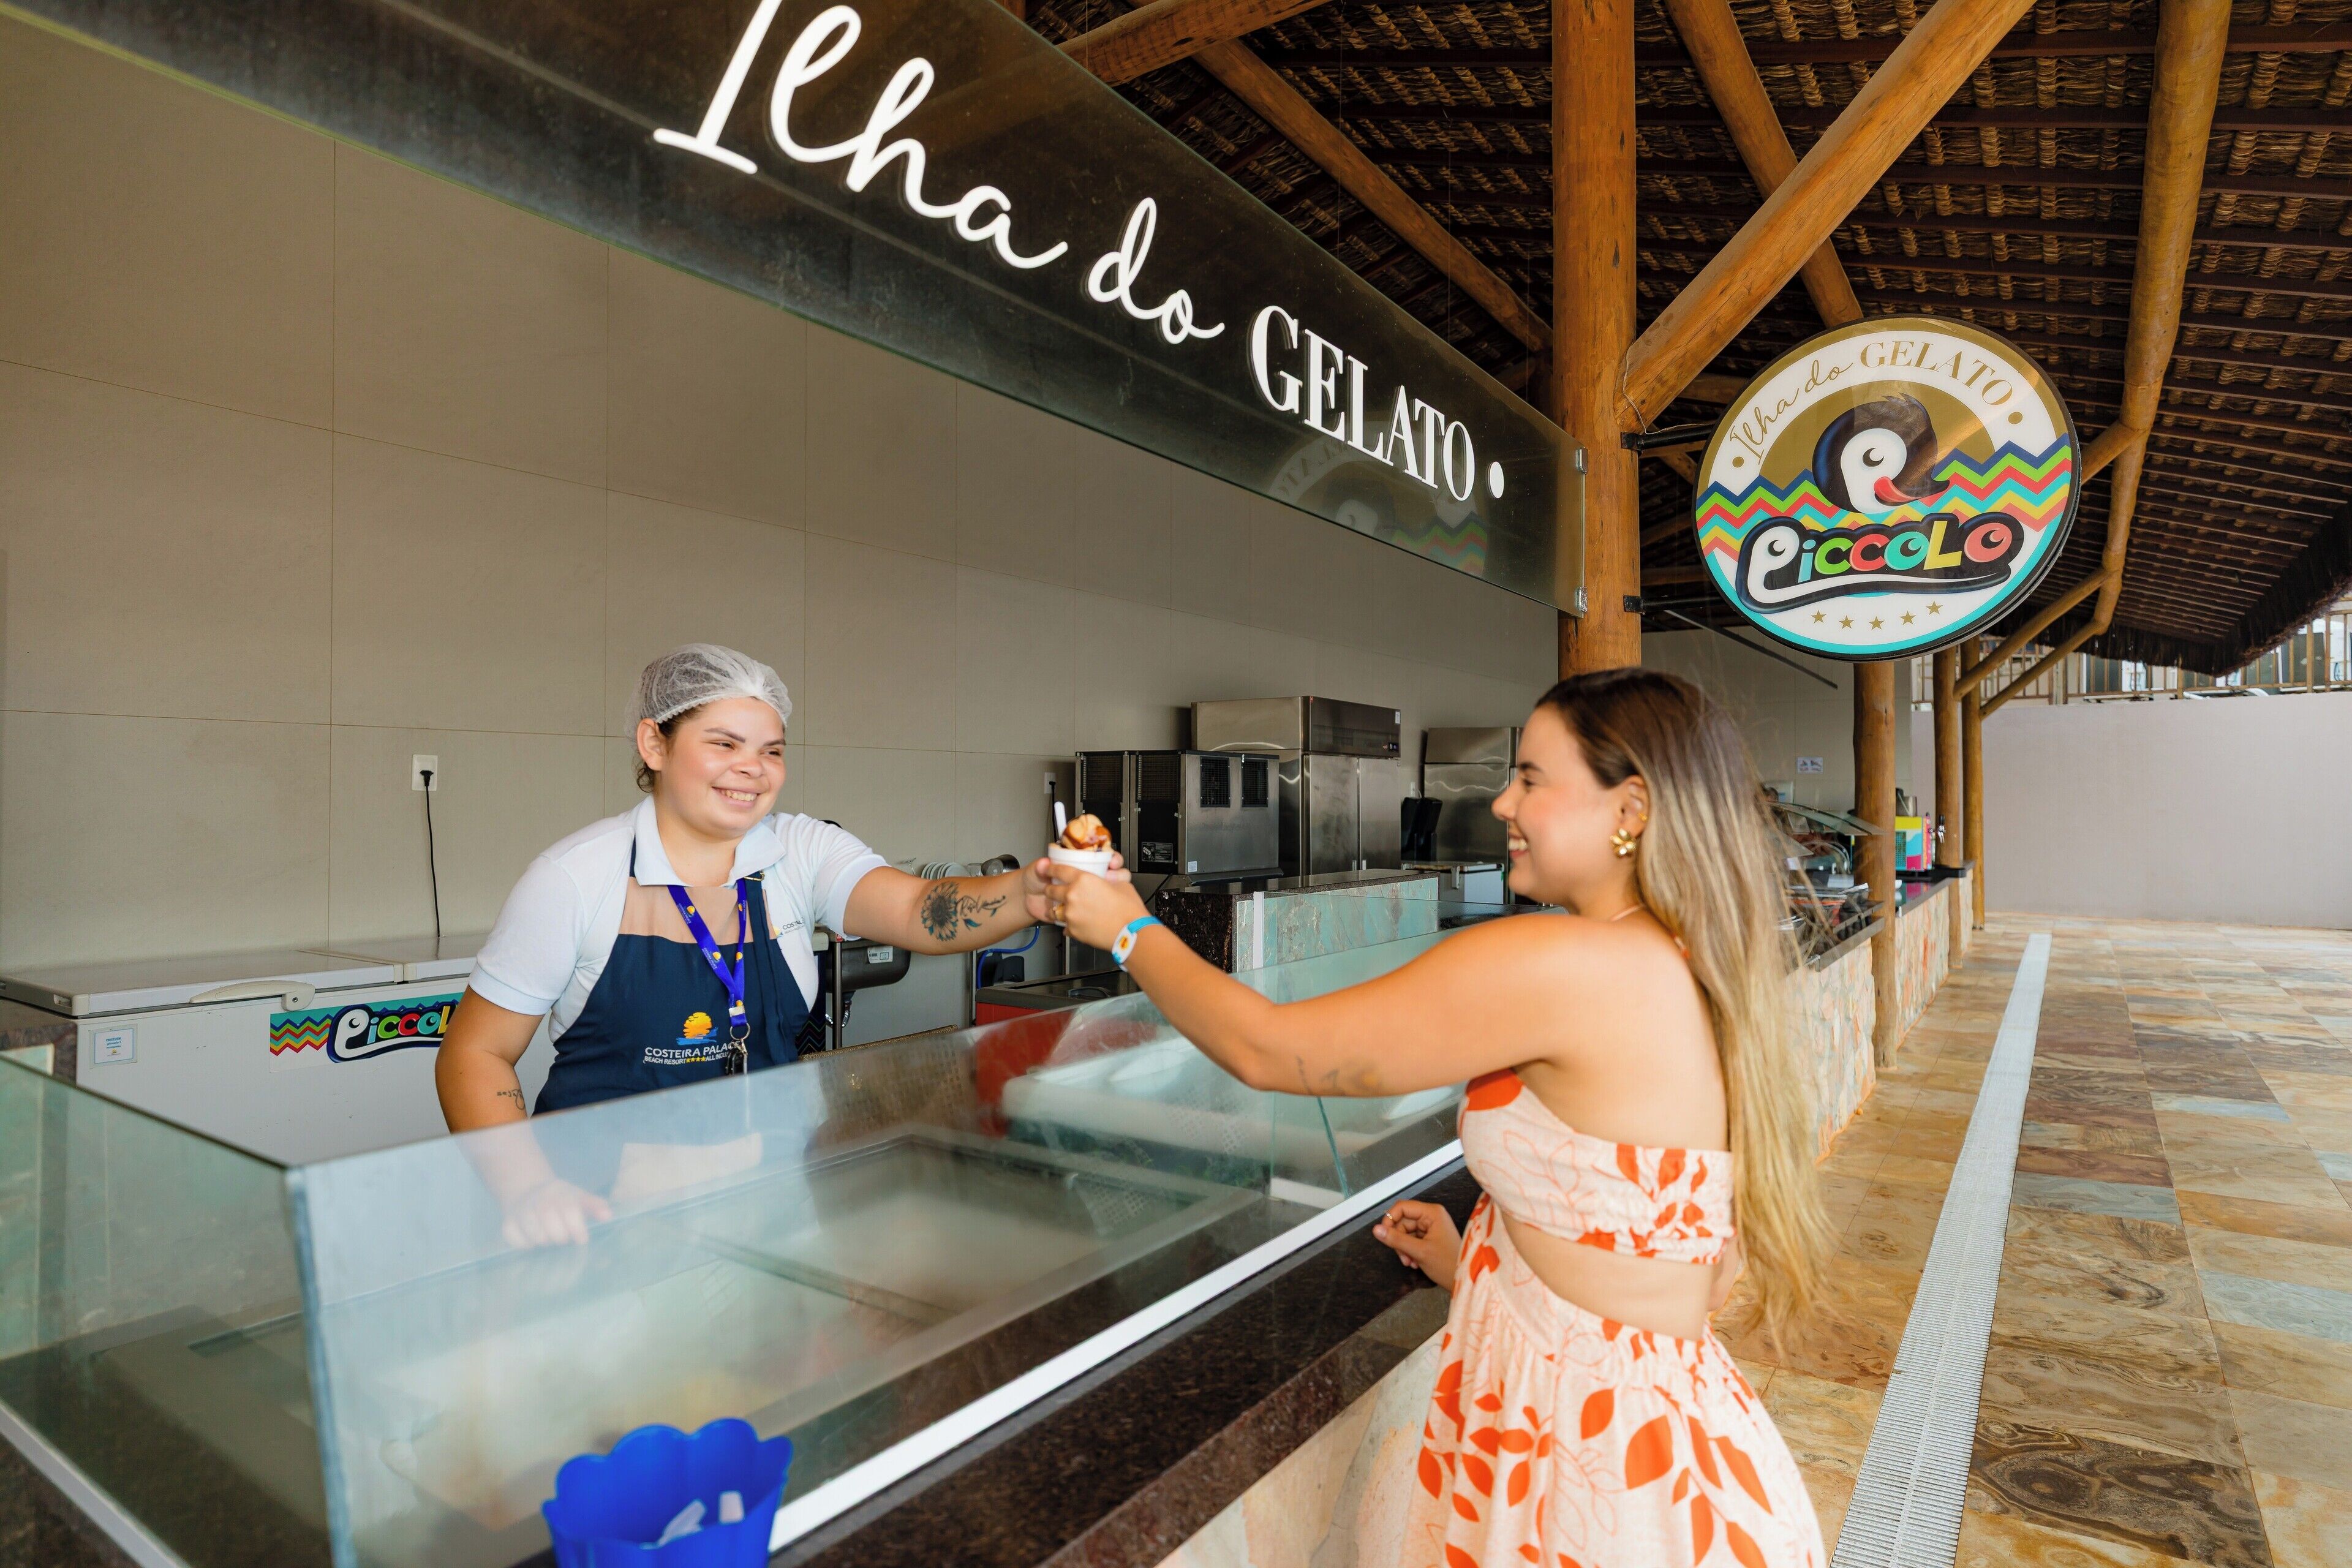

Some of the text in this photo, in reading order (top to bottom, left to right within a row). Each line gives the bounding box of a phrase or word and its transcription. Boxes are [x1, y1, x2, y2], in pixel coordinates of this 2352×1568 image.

[653, 0, 1476, 502] Ilha do GELATO
[1729, 341, 2013, 465] Ilha do GELATO
[644, 1055, 663, 1064] BEACH
[645, 1047, 701, 1058] COSTEIRA
